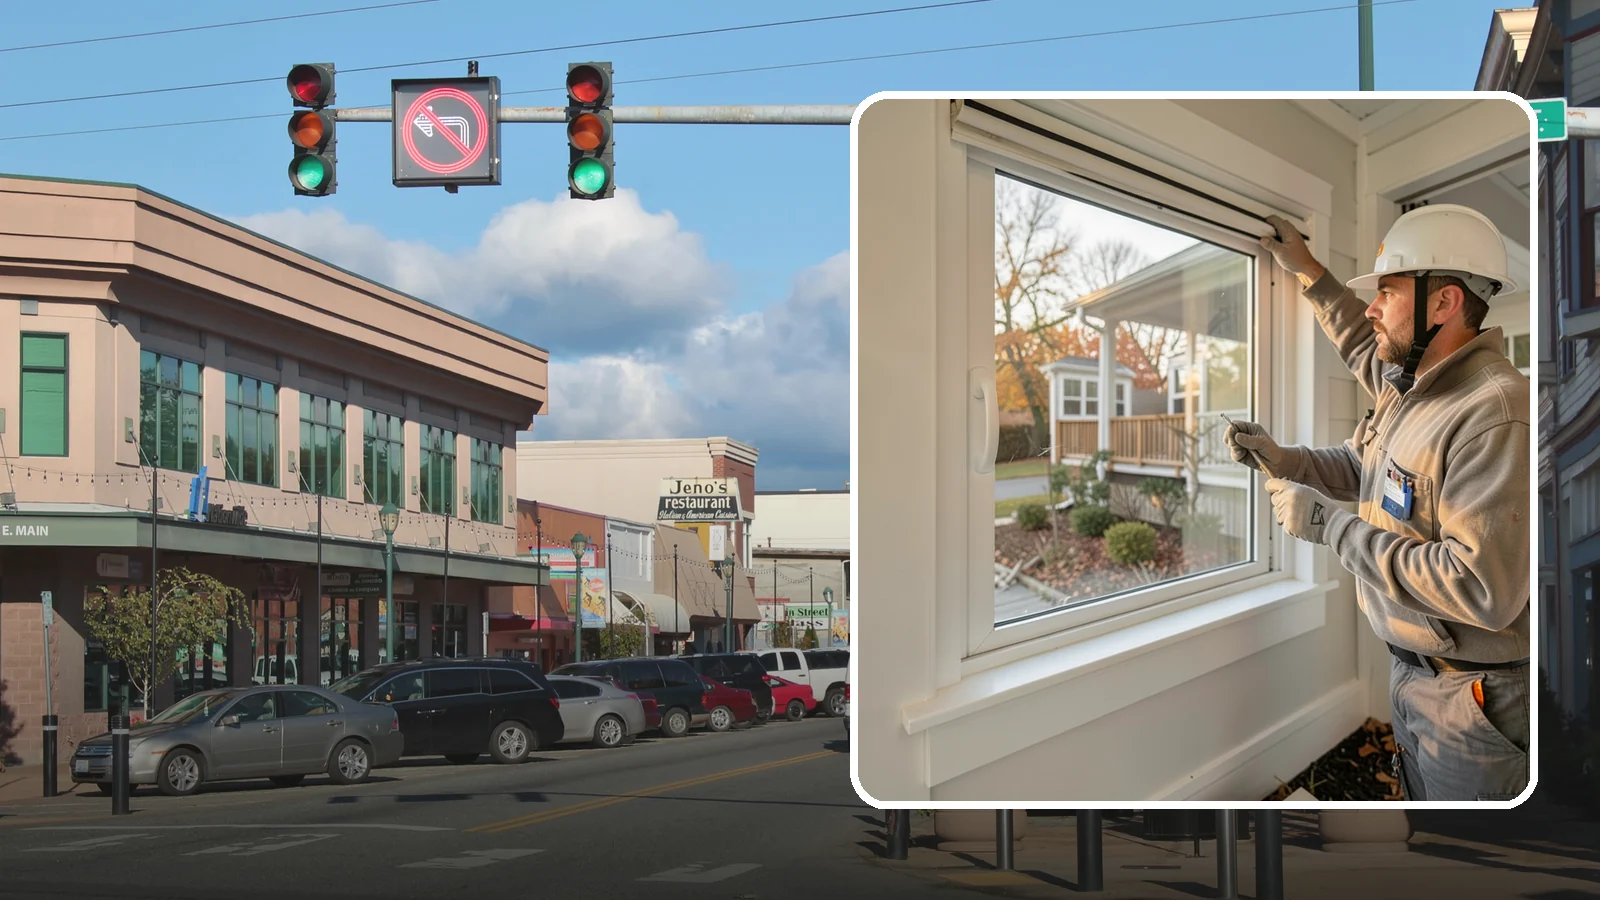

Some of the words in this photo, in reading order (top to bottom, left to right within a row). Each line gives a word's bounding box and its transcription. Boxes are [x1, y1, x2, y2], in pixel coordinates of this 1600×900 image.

[670, 480, 727, 494] Jeno's
[665, 497, 731, 509] restaurant
[658, 510, 681, 519] Italian
[686, 510, 714, 519] American
[715, 509, 737, 519] Cuisine
[2, 525, 13, 536] E.
[15, 525, 49, 536] MAIN
[797, 607, 828, 617] Street
